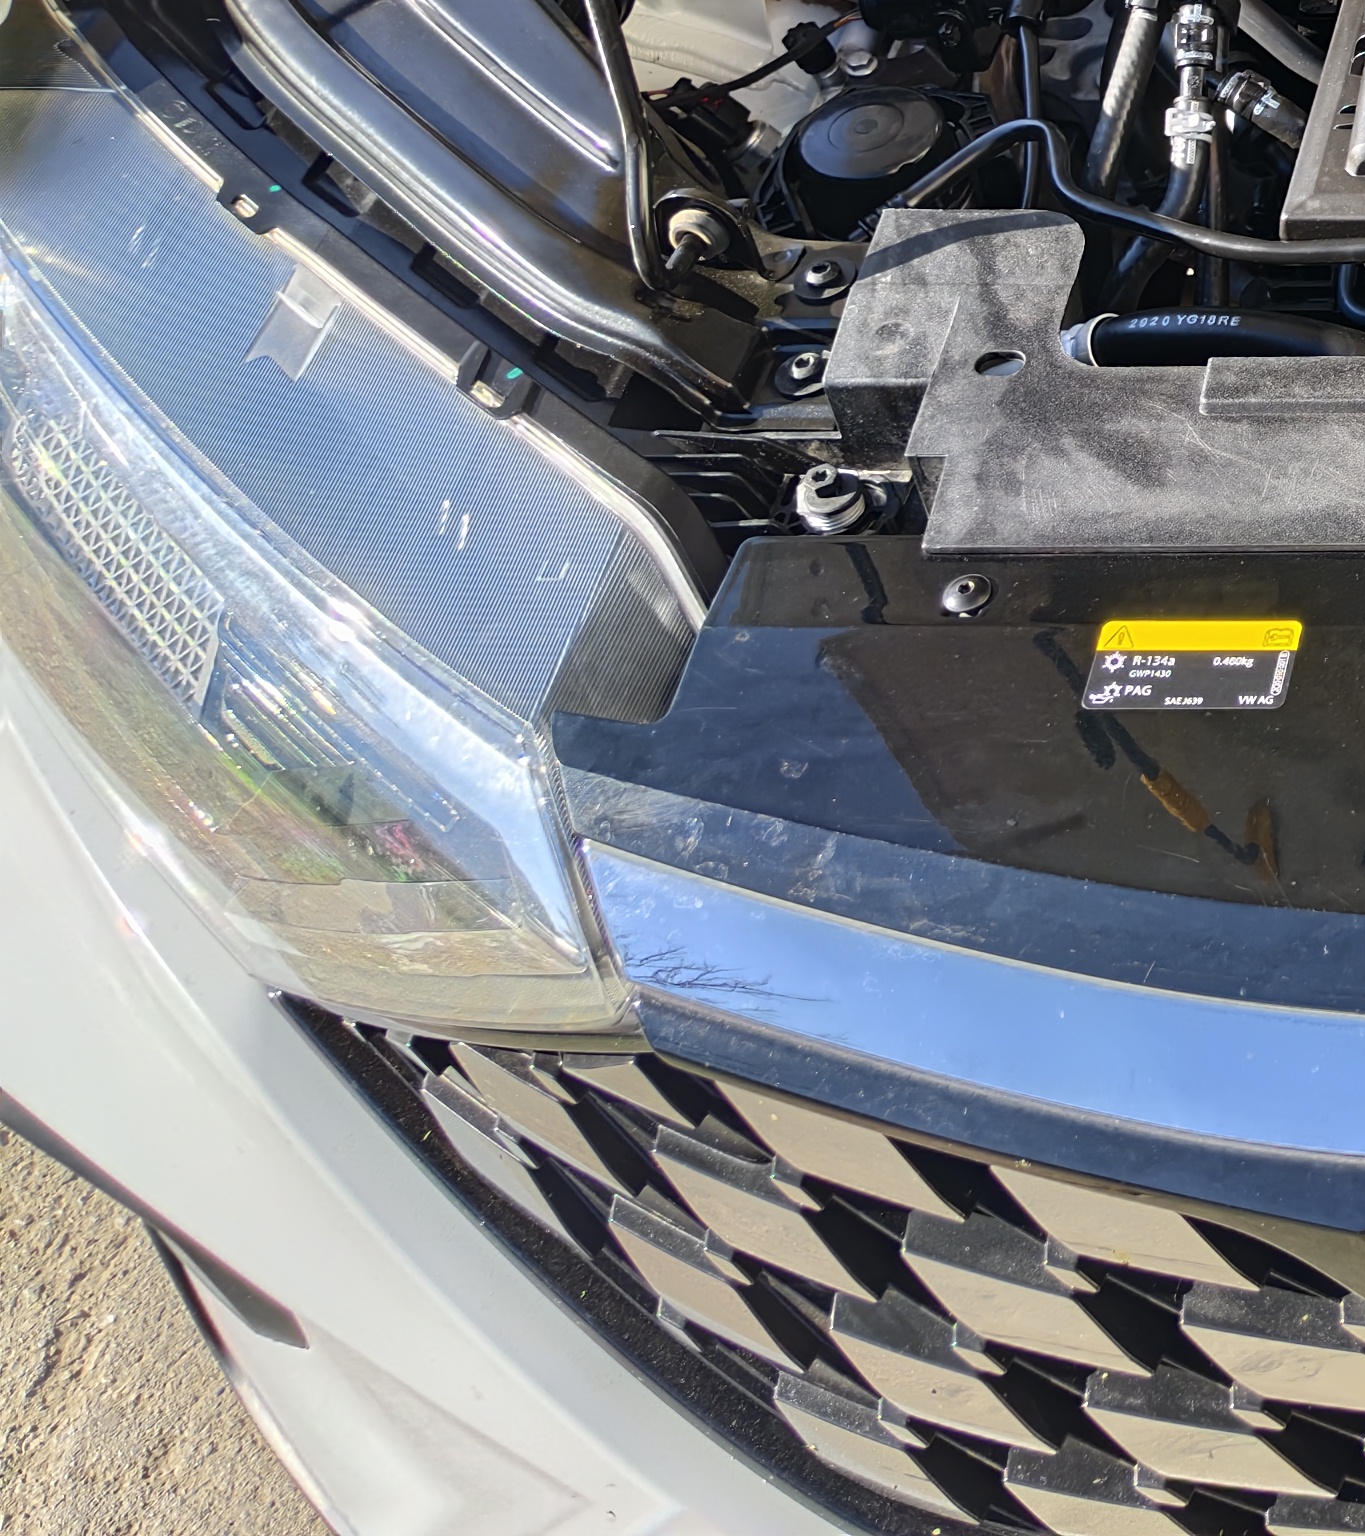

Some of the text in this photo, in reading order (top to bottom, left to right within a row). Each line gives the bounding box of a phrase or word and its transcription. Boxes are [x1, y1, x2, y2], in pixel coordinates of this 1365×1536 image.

[1128, 316, 1171, 328] 2020
[1132, 655, 1176, 667] R-134a
[1128, 669, 1172, 678] GWP1430
[1124, 685, 1152, 696] PAG
[1238, 695, 1257, 705] VW
[1257, 695, 1274, 705] AG
